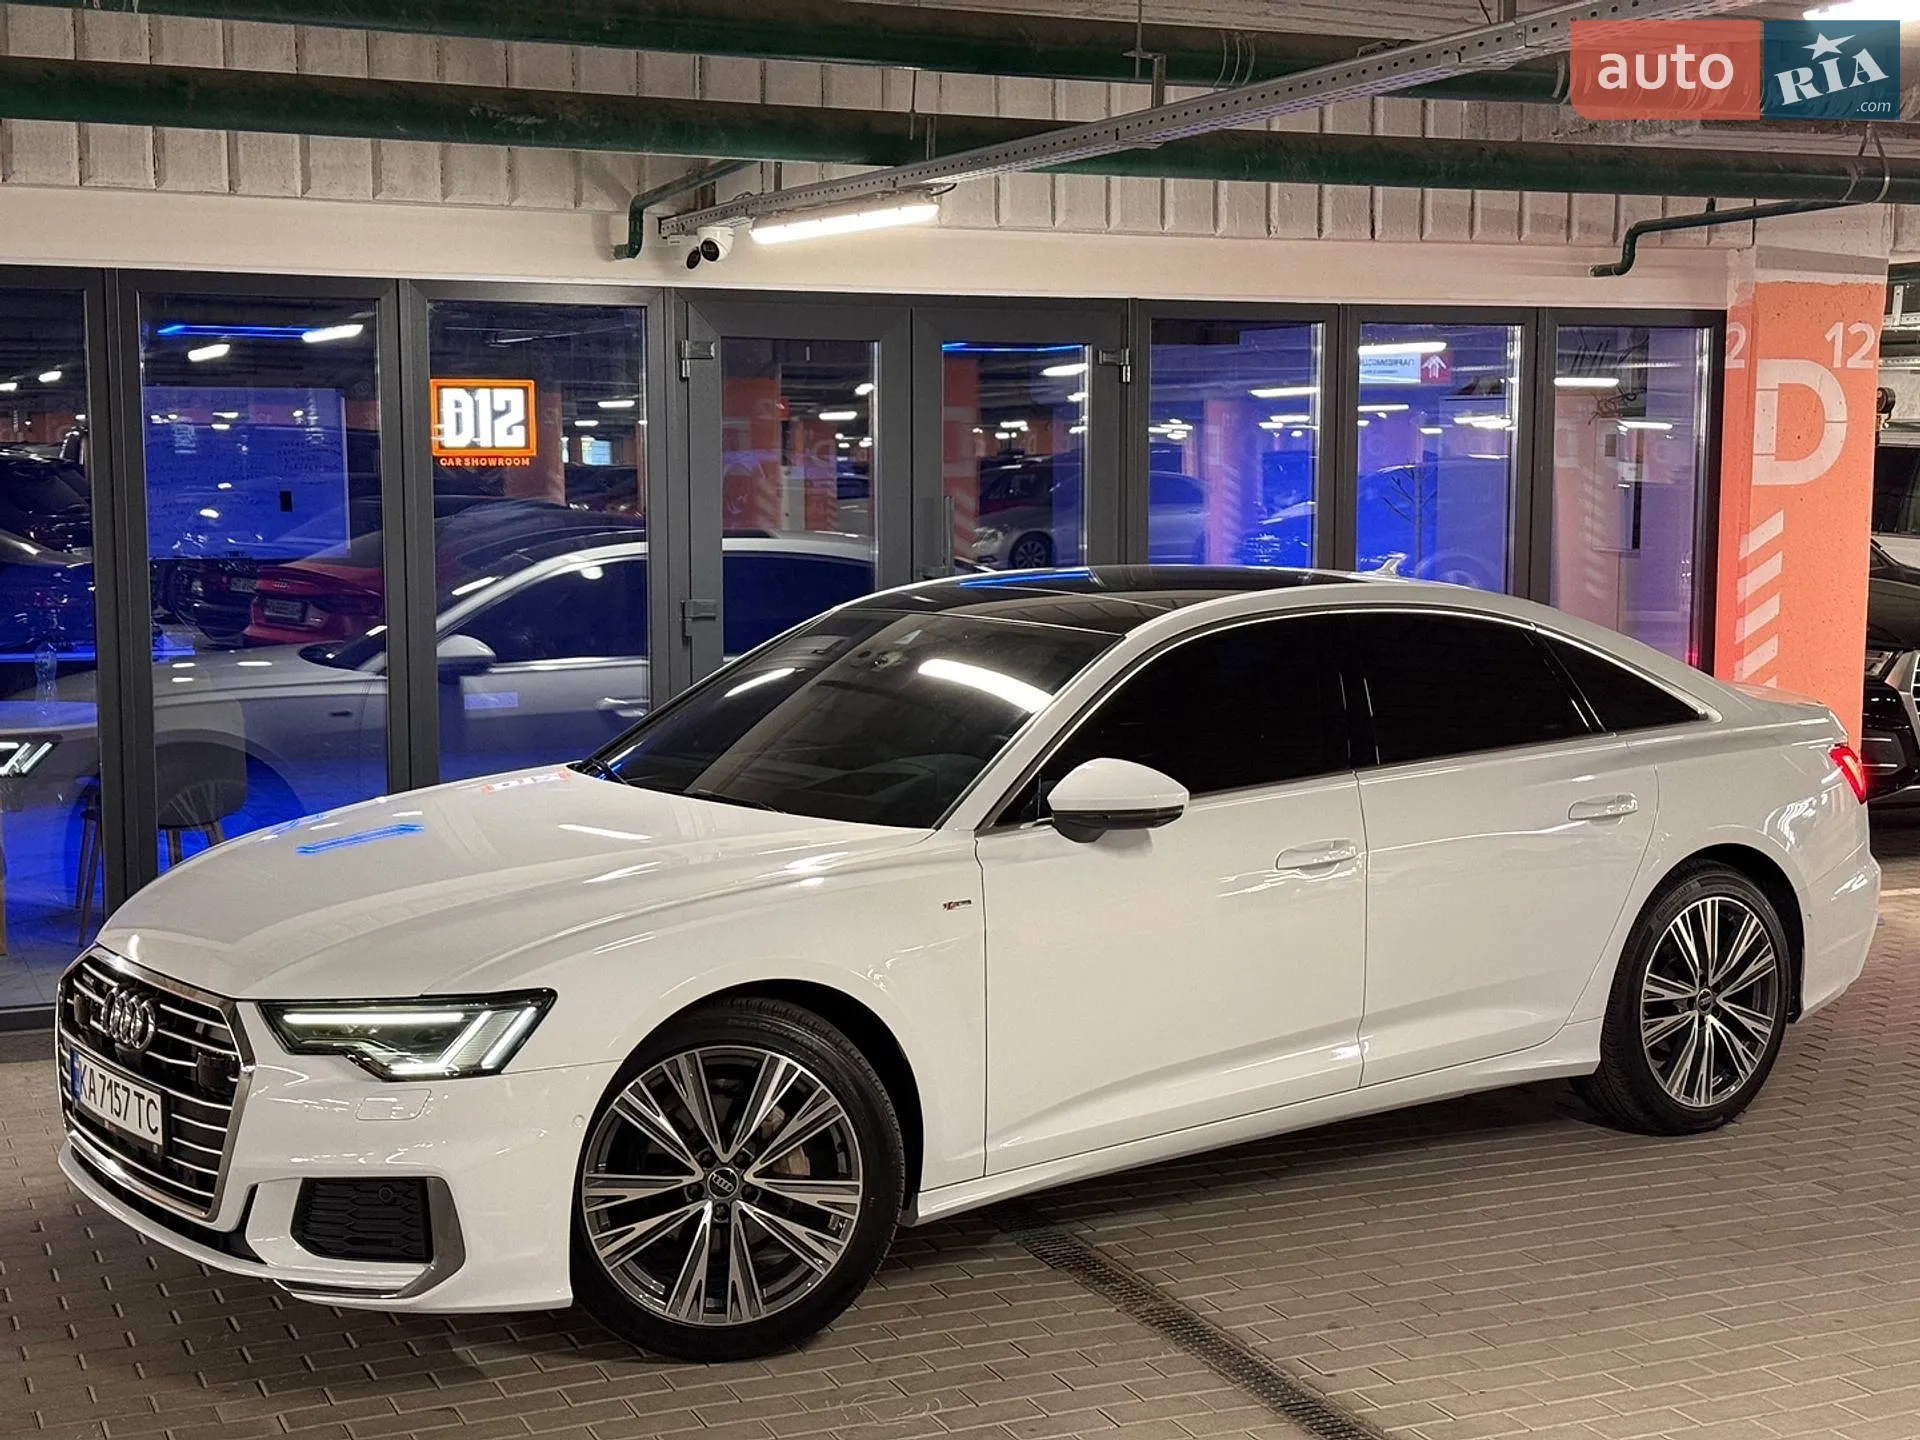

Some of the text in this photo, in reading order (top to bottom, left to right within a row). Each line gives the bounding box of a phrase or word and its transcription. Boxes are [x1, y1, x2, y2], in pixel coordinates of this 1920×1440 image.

[1824, 321, 1876, 369] 12
[442, 388, 526, 448] D12
[1752, 358, 1848, 486] D
[80, 1062, 98, 1105] KA
[98, 1074, 131, 1122] 7157
[133, 1090, 159, 1135] TC
